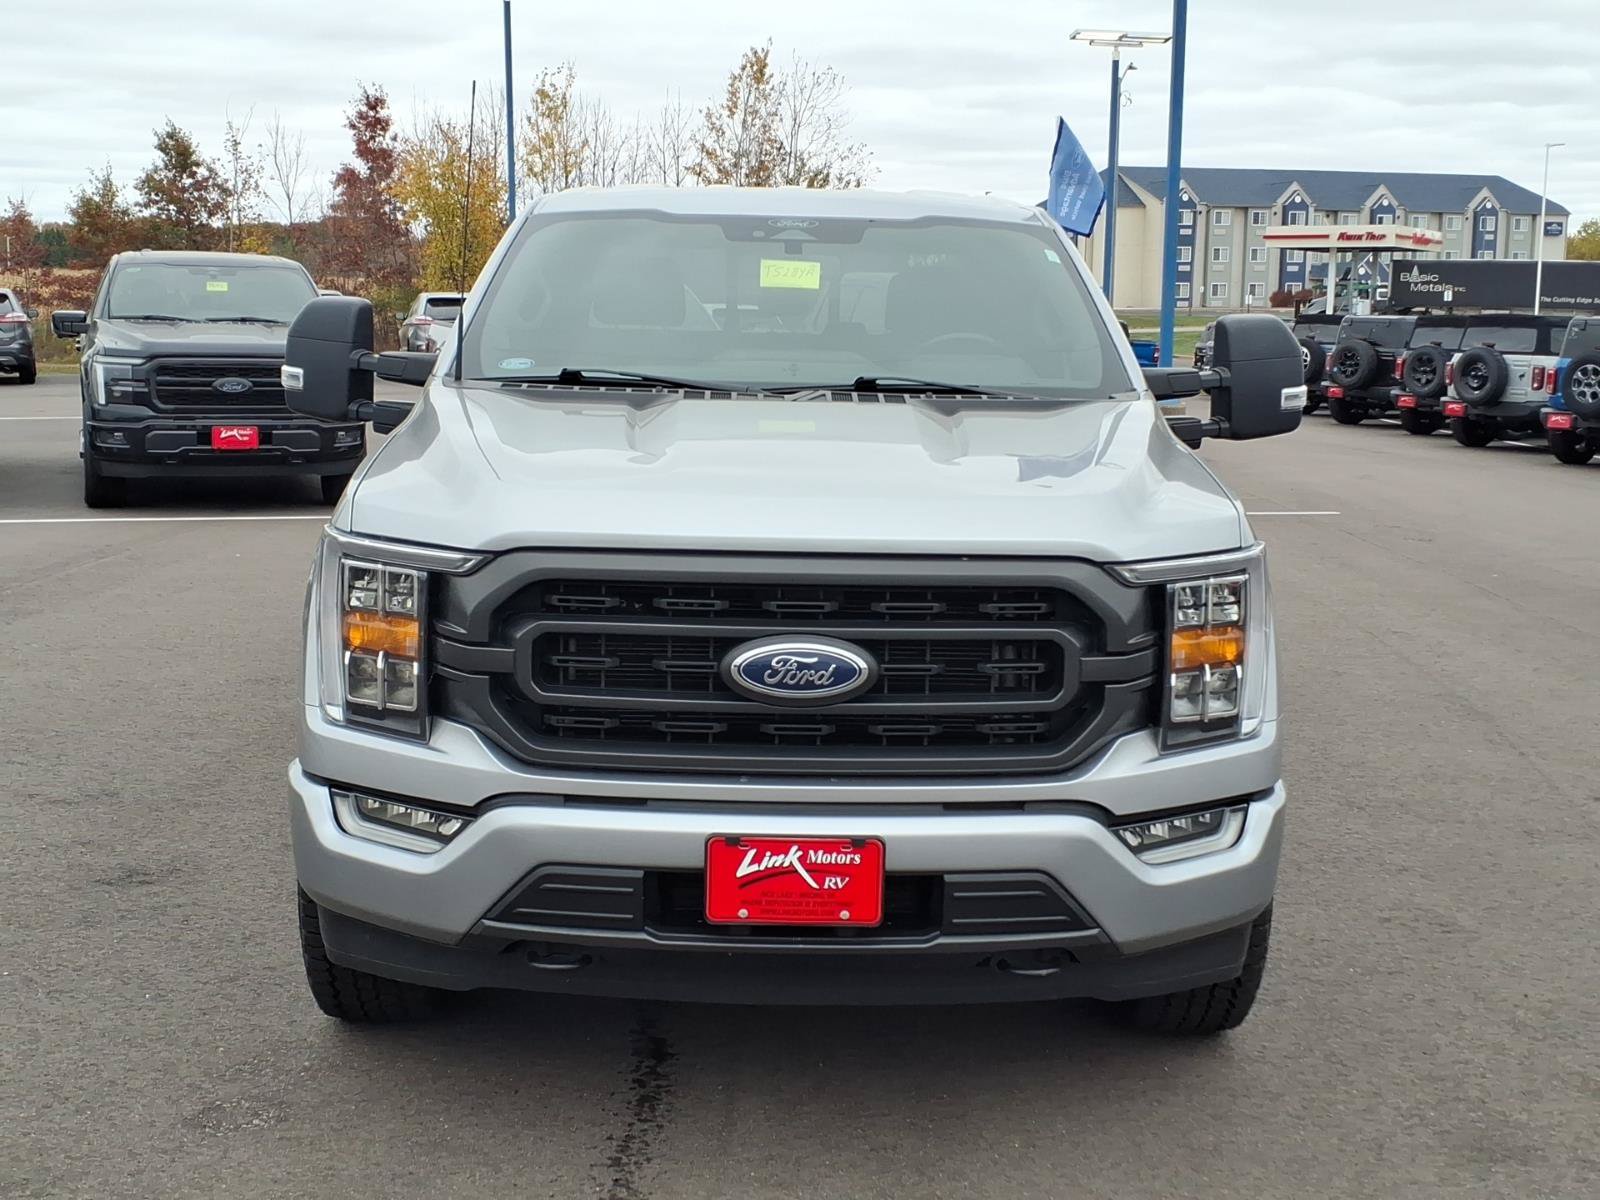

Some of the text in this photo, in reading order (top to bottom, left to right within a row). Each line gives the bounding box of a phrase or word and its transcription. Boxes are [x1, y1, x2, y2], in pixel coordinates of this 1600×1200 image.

[1400, 272, 1439, 282] Basic
[1410, 283, 1453, 292] Metals
[1552, 296, 1575, 304] Cutting
[1576, 296, 1592, 304] Edge
[763, 655, 837, 685] Ford
[736, 845, 861, 890] Link Motors
[823, 877, 850, 890] RV
